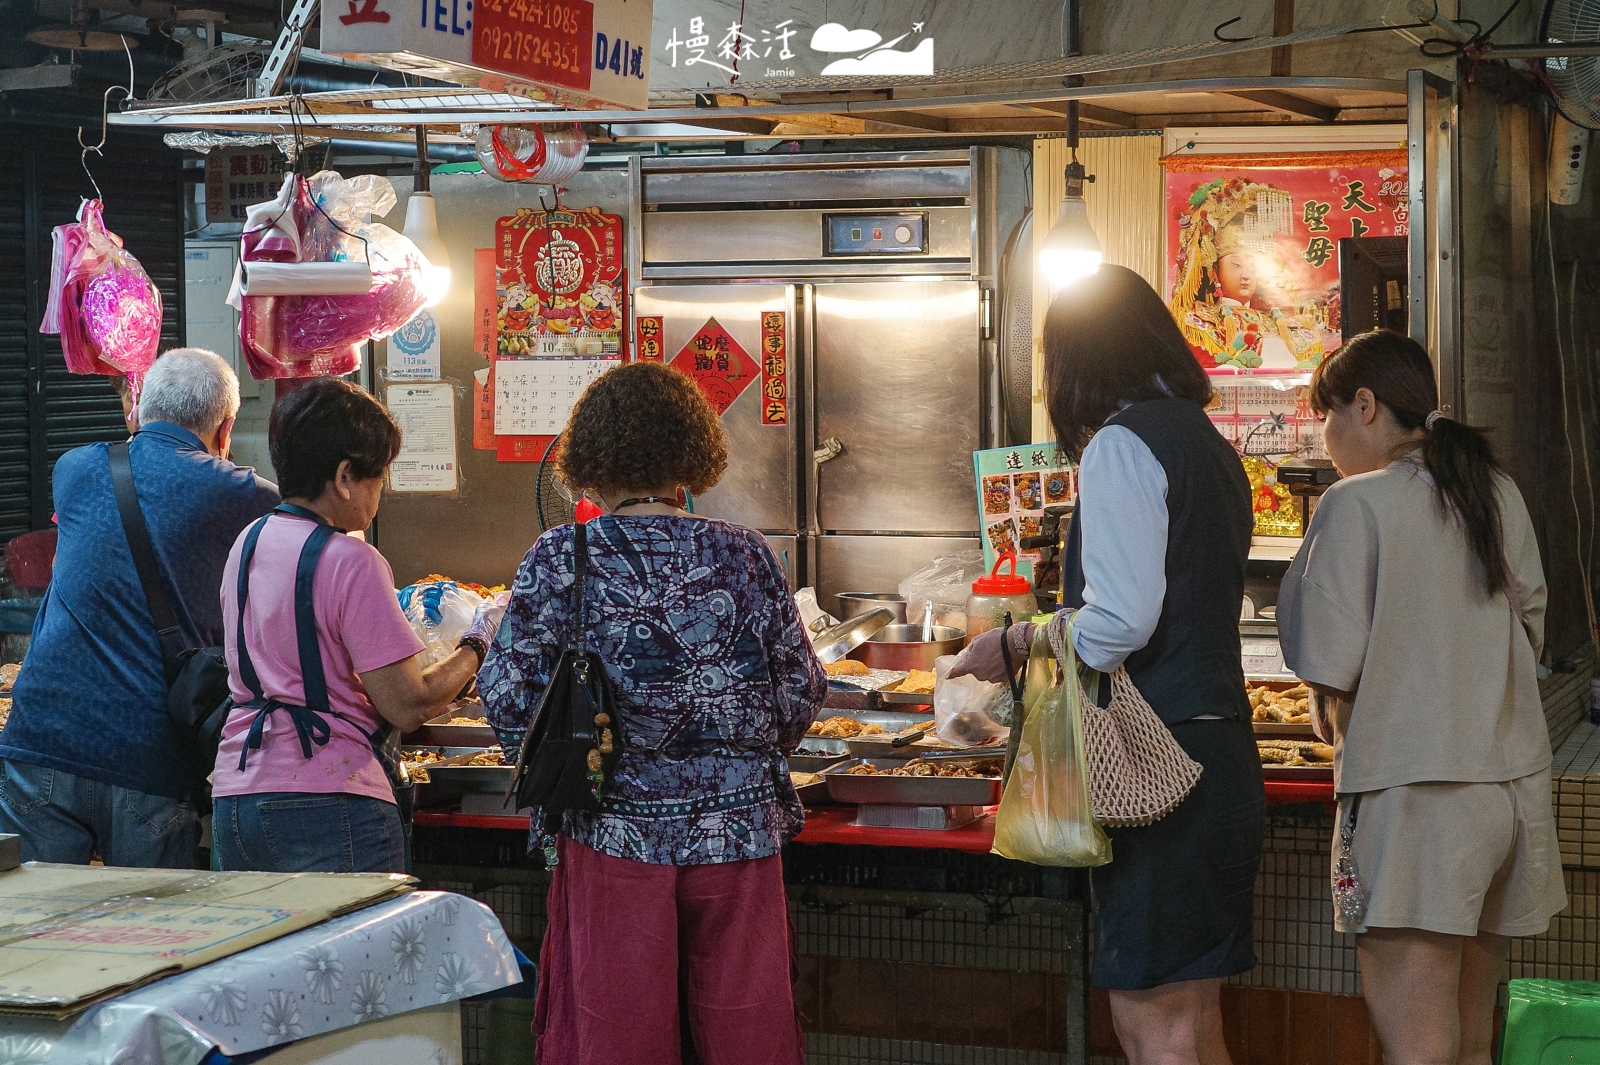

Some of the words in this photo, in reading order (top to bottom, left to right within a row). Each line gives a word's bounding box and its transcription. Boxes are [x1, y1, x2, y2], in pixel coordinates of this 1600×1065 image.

[481, 0, 581, 35] 2-24241085
[481, 26, 581, 74] 0927524351
[1342, 181, 1376, 238] 天上
[1378, 181, 1409, 196] 202
[1303, 200, 1335, 268] 聖母
[543, 342, 554, 353] 10
[641, 317, 660, 358] 好運
[764, 312, 787, 422] 壞事龍過去
